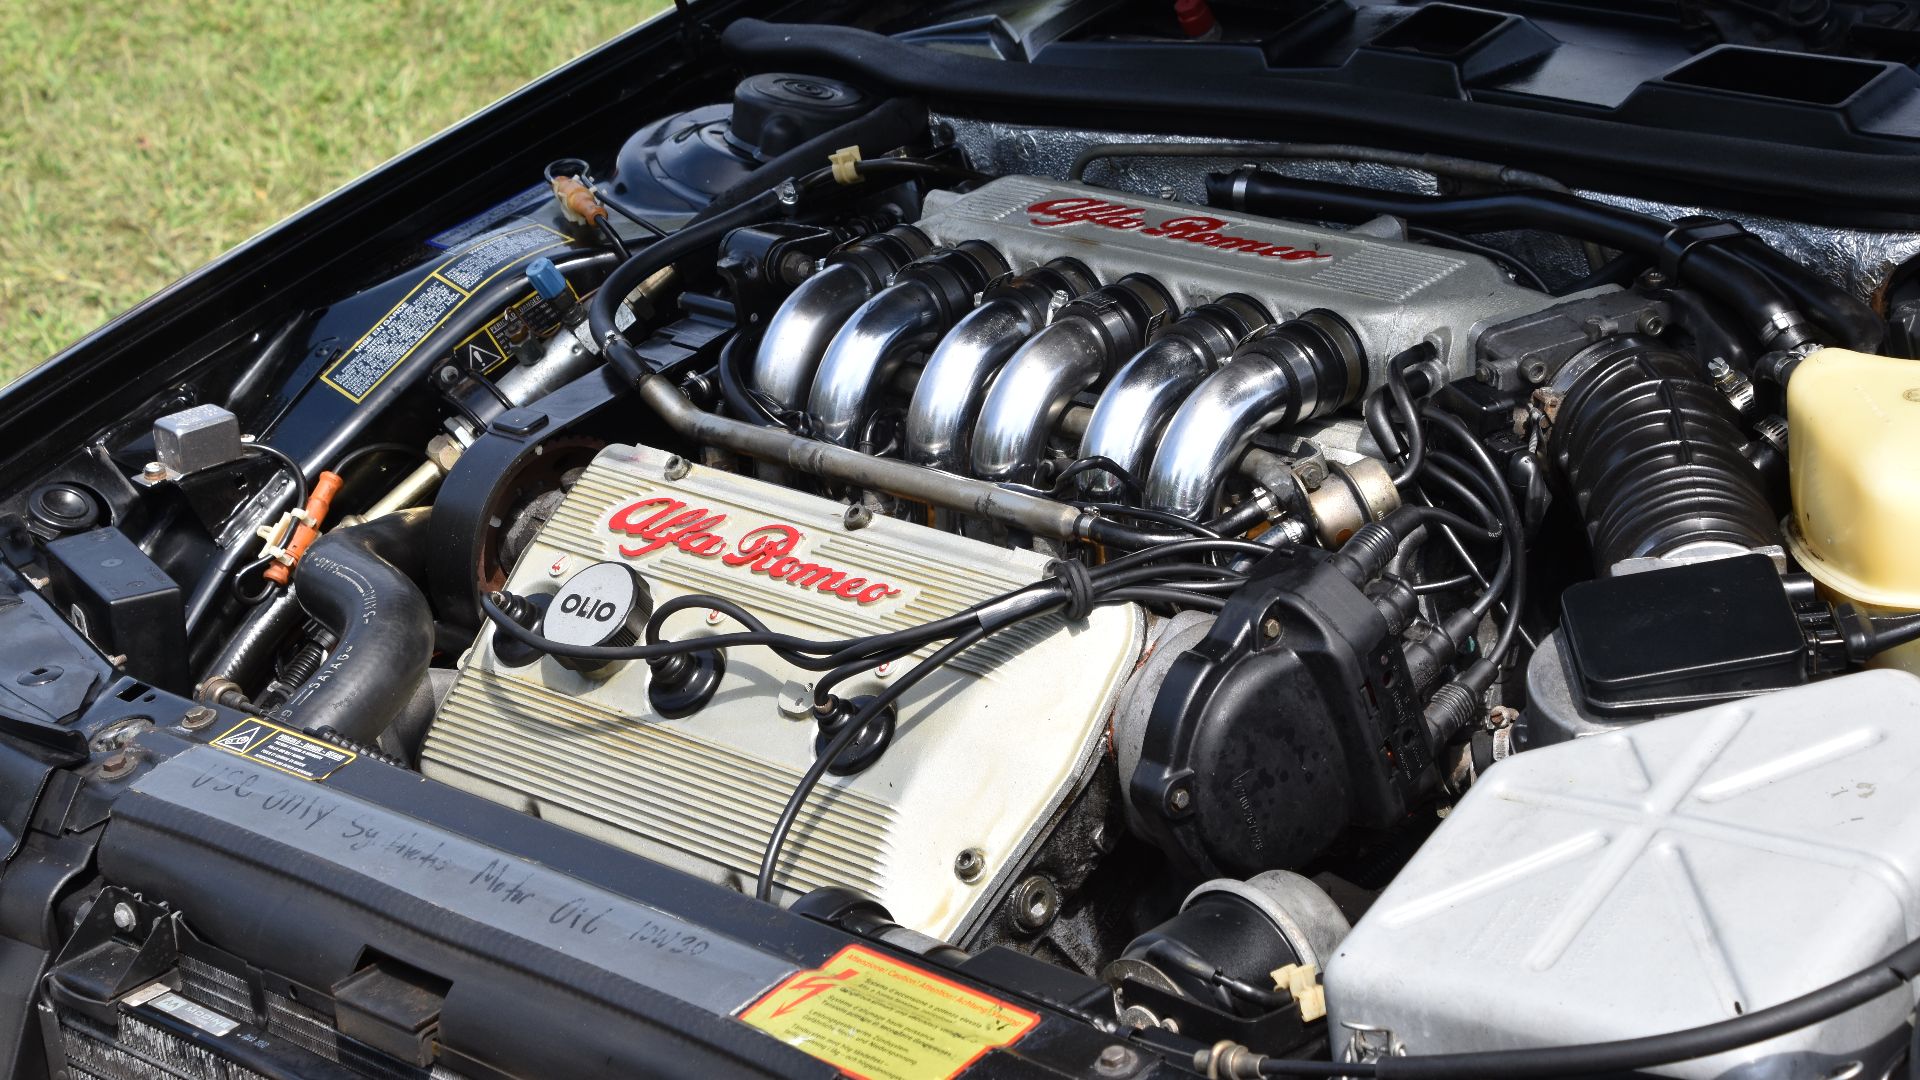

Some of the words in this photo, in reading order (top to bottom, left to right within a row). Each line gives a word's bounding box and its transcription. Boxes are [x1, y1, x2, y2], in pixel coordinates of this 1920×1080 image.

[1026, 198, 1146, 229] Alfa
[1140, 216, 1333, 264] Romeo
[372, 325, 385, 337] EN
[383, 301, 409, 326] GARDE
[608, 497, 728, 560] Alfa
[722, 524, 901, 605] Romeo
[560, 593, 616, 622] OLIO
[469, 858, 536, 905] Motor
